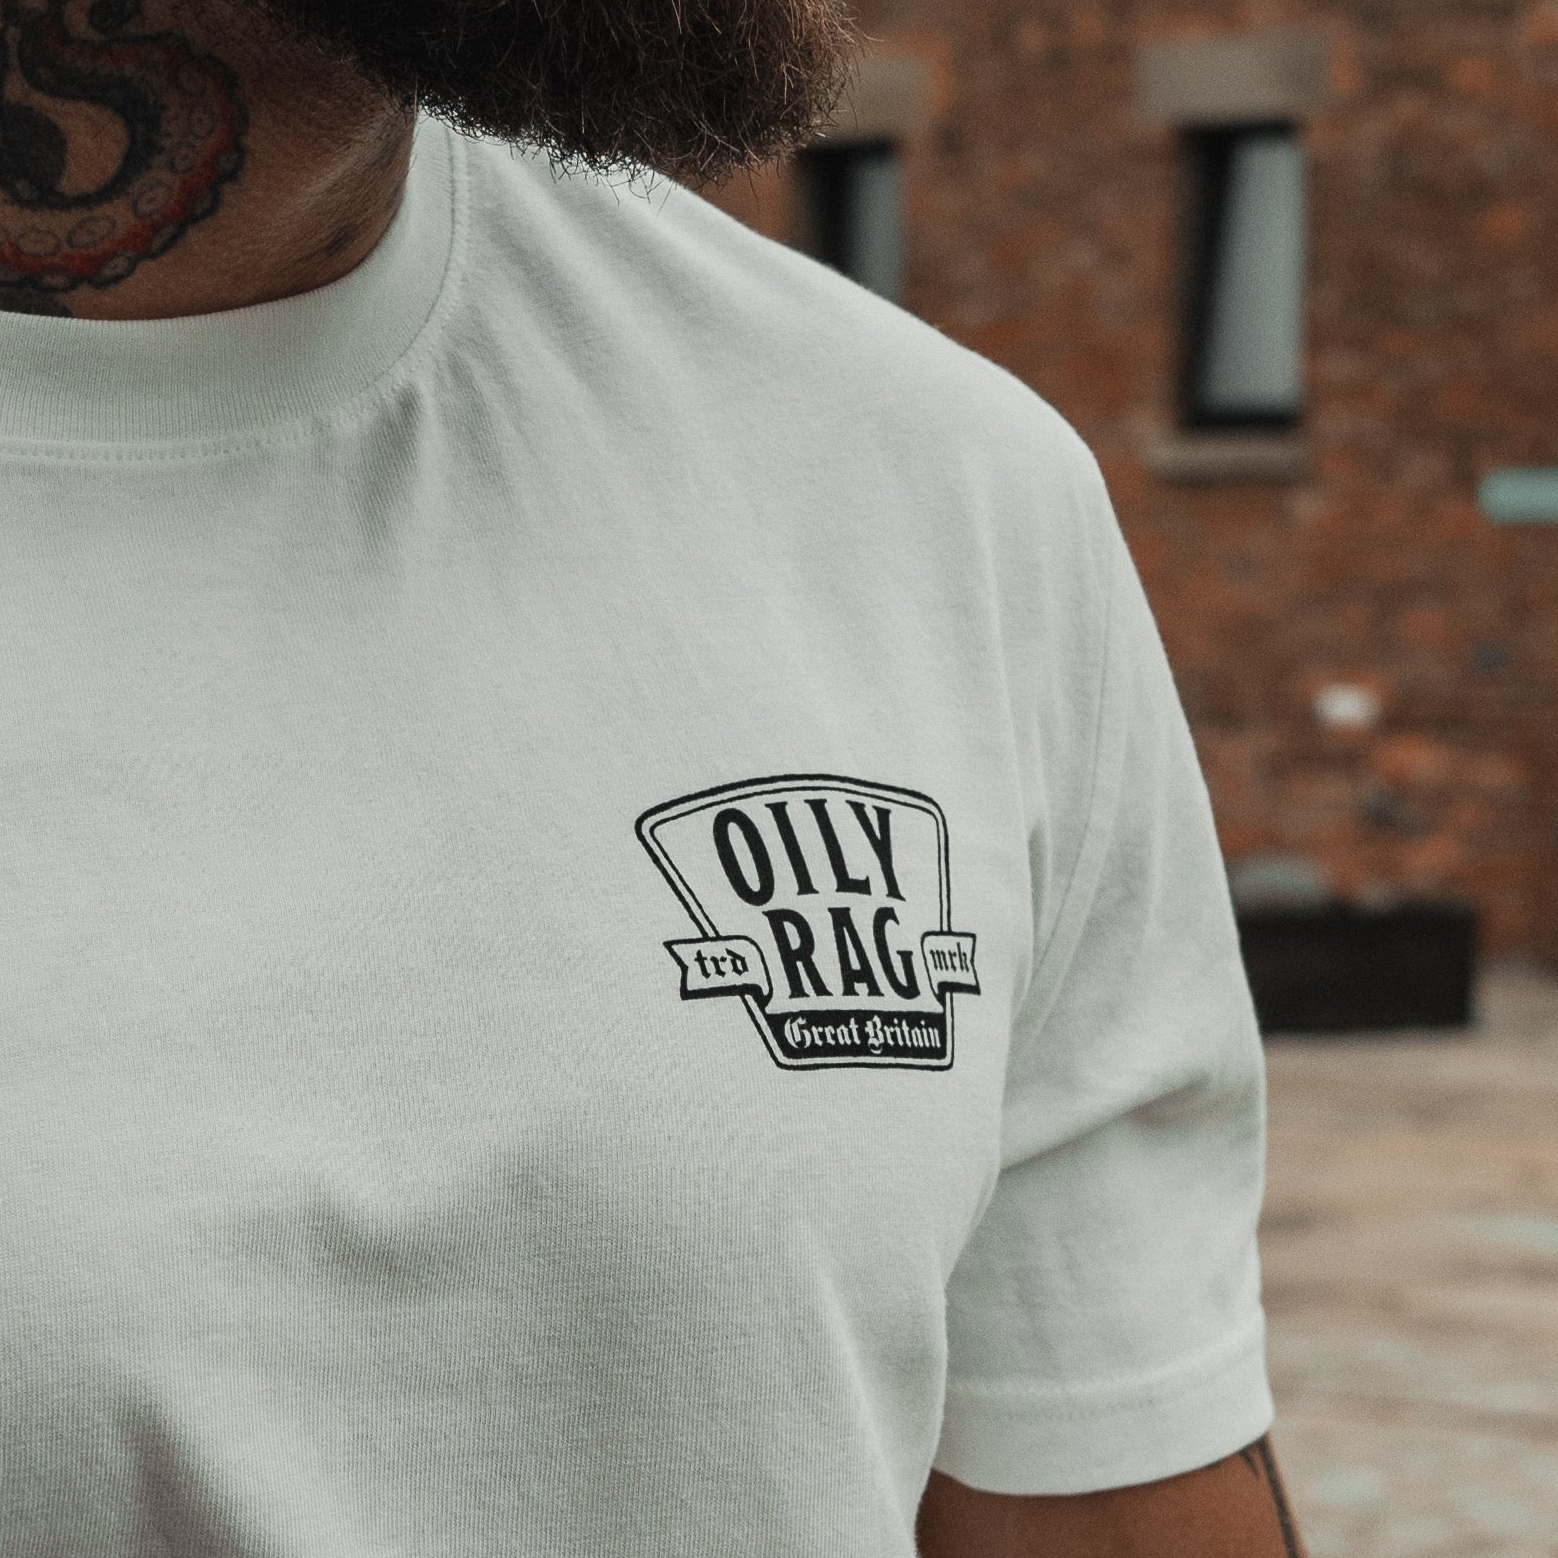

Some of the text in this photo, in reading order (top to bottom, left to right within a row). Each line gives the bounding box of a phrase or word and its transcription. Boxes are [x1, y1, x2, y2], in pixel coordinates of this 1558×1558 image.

[712, 797, 906, 907] OILY
[694, 947, 749, 979] trd
[762, 906, 921, 1000] RAG
[784, 1014, 941, 1054] Great Britain
